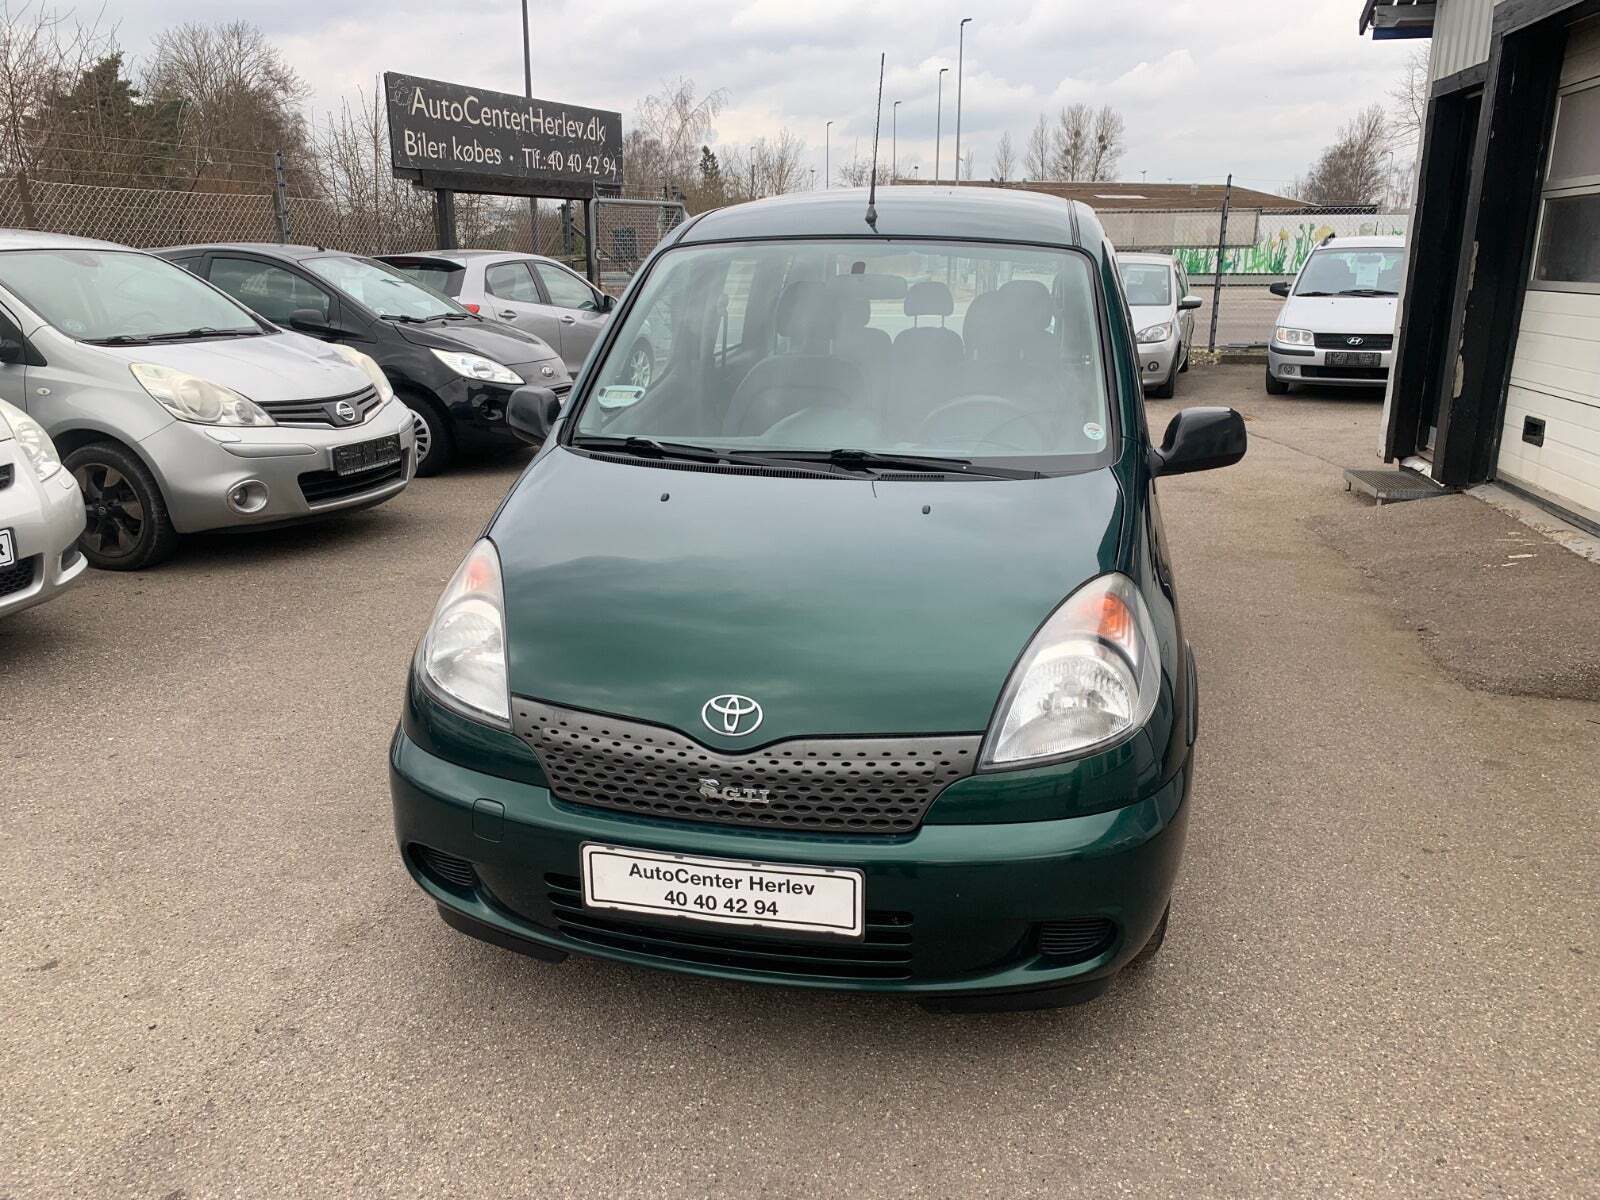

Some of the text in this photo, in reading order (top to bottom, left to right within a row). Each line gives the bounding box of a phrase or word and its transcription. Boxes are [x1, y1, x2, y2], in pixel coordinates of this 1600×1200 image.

[411, 86, 606, 143] AutoCenterHerlev.dk
[404, 129, 447, 159] Biler
[452, 136, 502, 165] købes
[567, 154, 582, 172] 40
[585, 155, 600, 174] 42
[603, 157, 617, 179] 94
[629, 863, 816, 897] AutoCenter Herlev
[664, 890, 779, 916] 40 40 42 94
